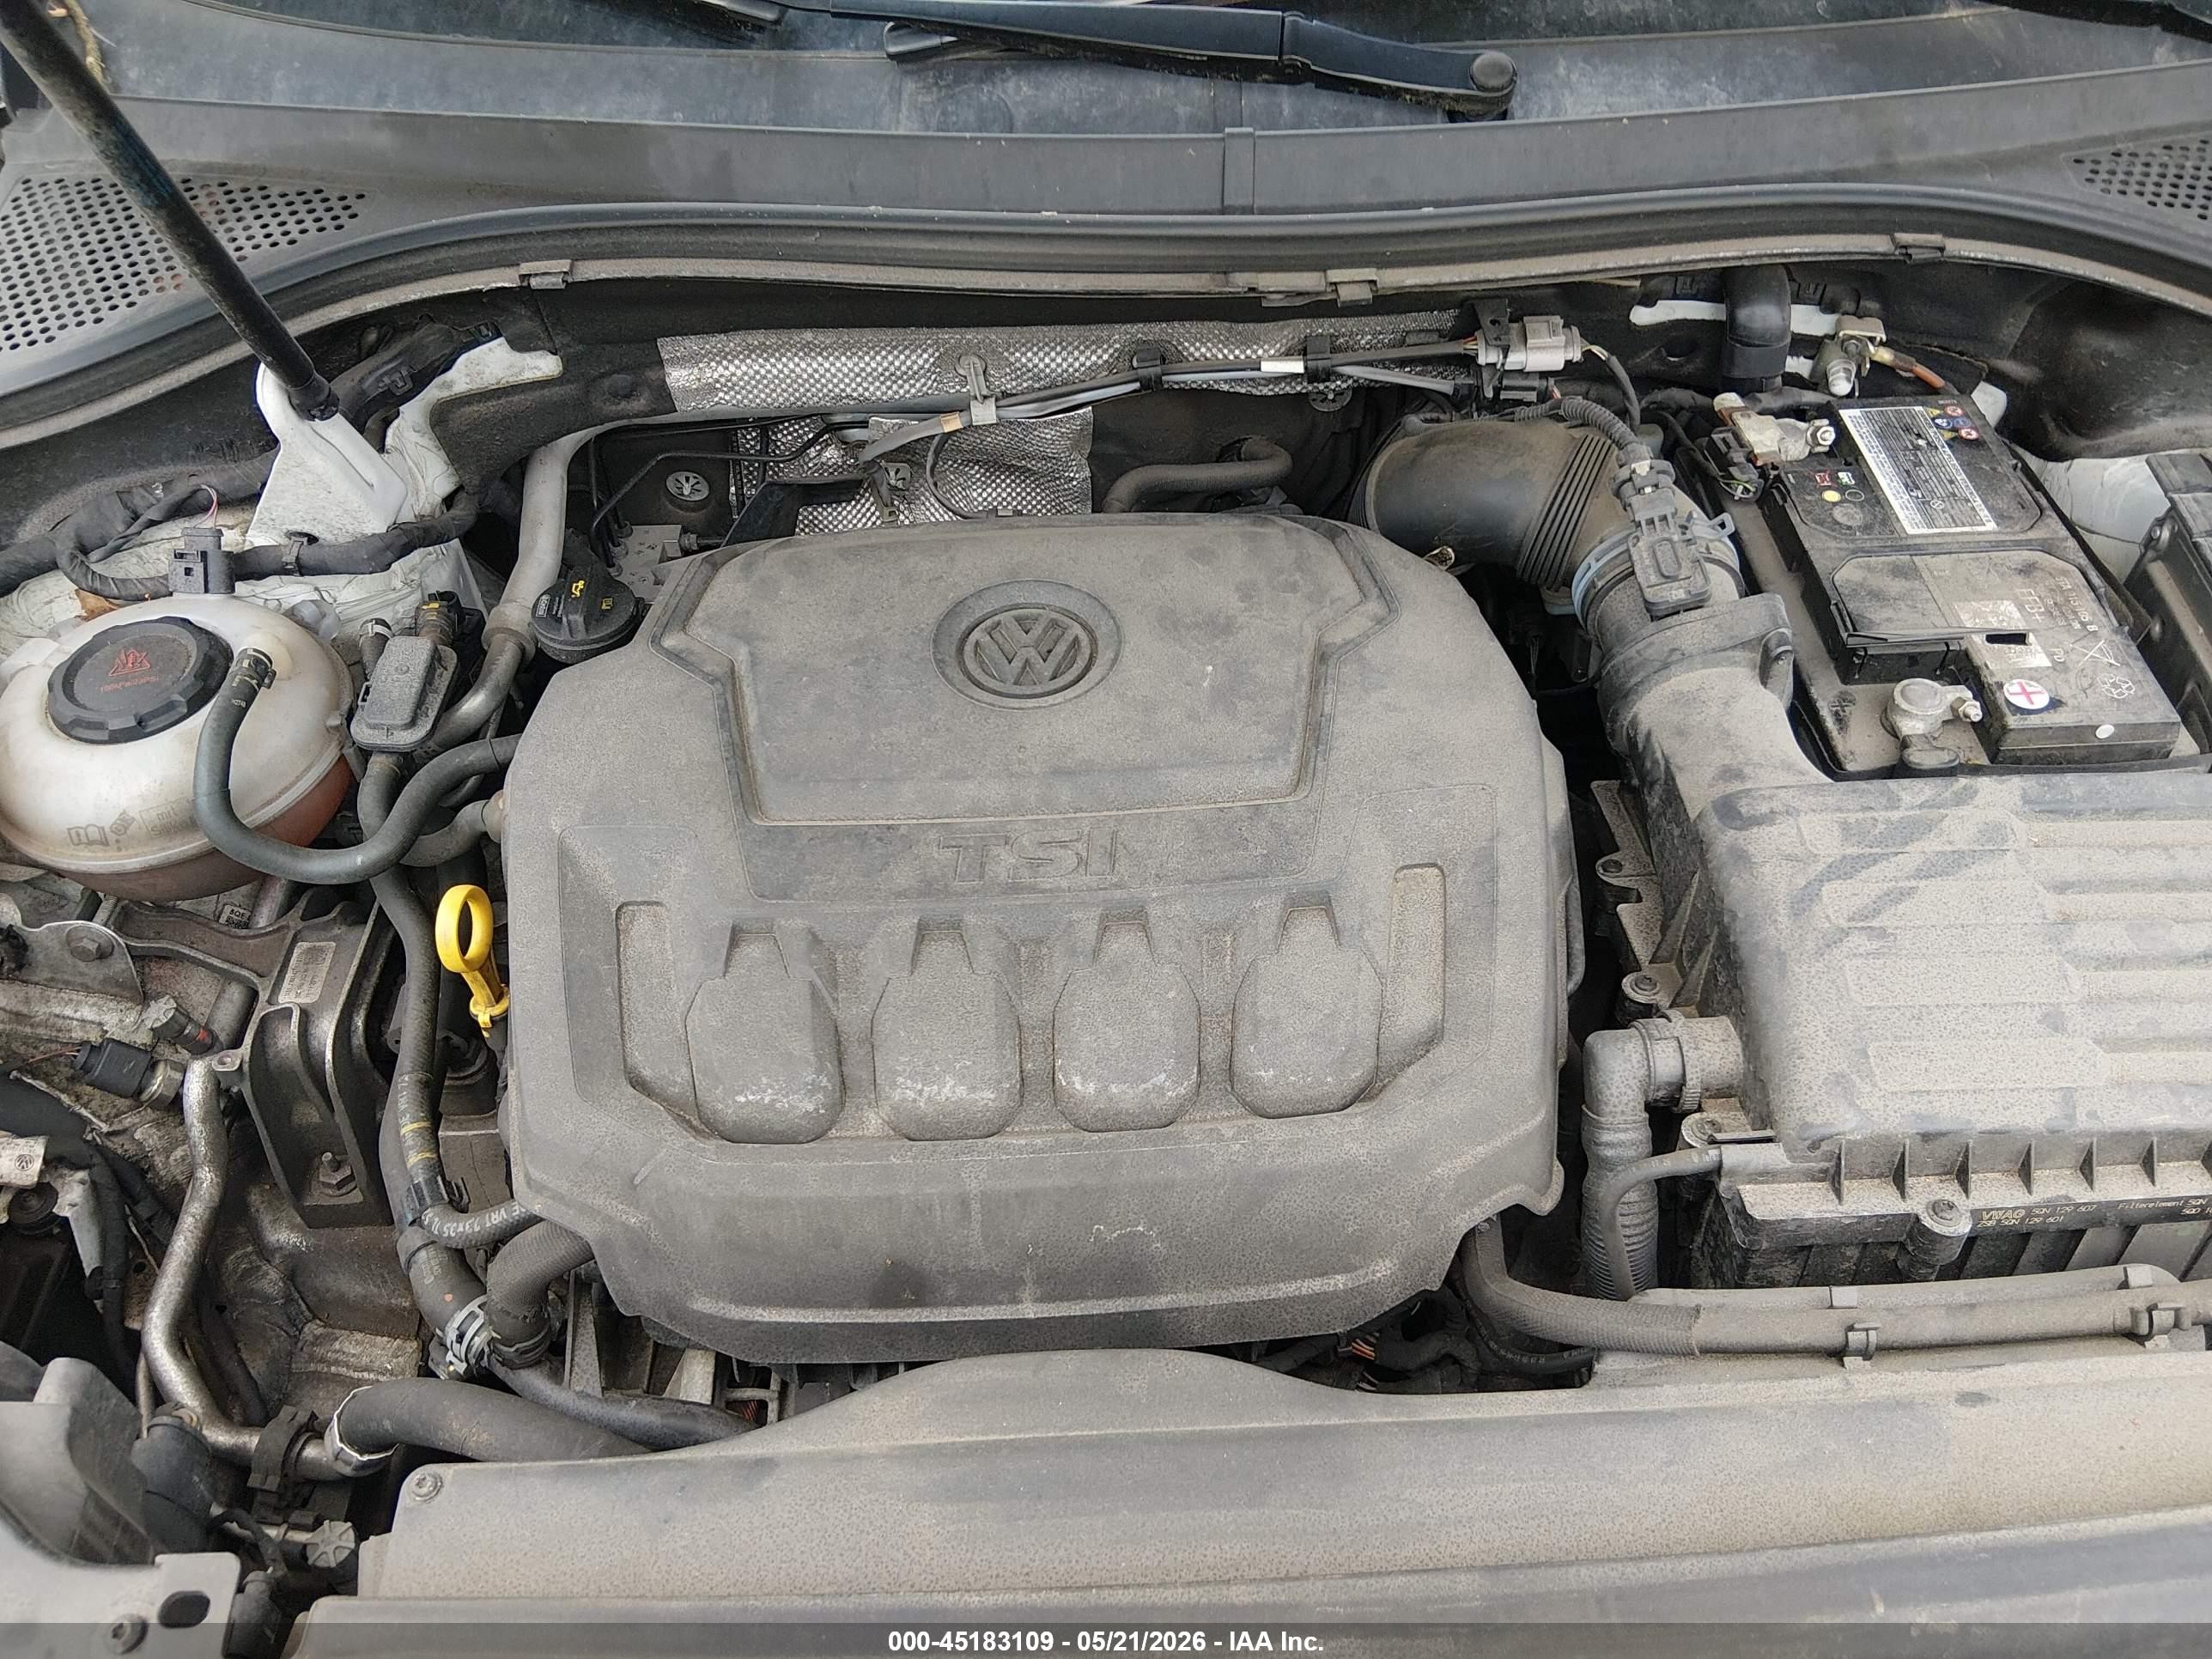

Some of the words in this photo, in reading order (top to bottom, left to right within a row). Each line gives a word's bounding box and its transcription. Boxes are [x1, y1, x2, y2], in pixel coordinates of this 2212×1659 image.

[939, 826, 1119, 885] TSI
[2118, 1200, 2185, 1209] Filterelement
[1981, 1208, 2026, 1220] VWAG
[2057, 1205, 2074, 1213] 129
